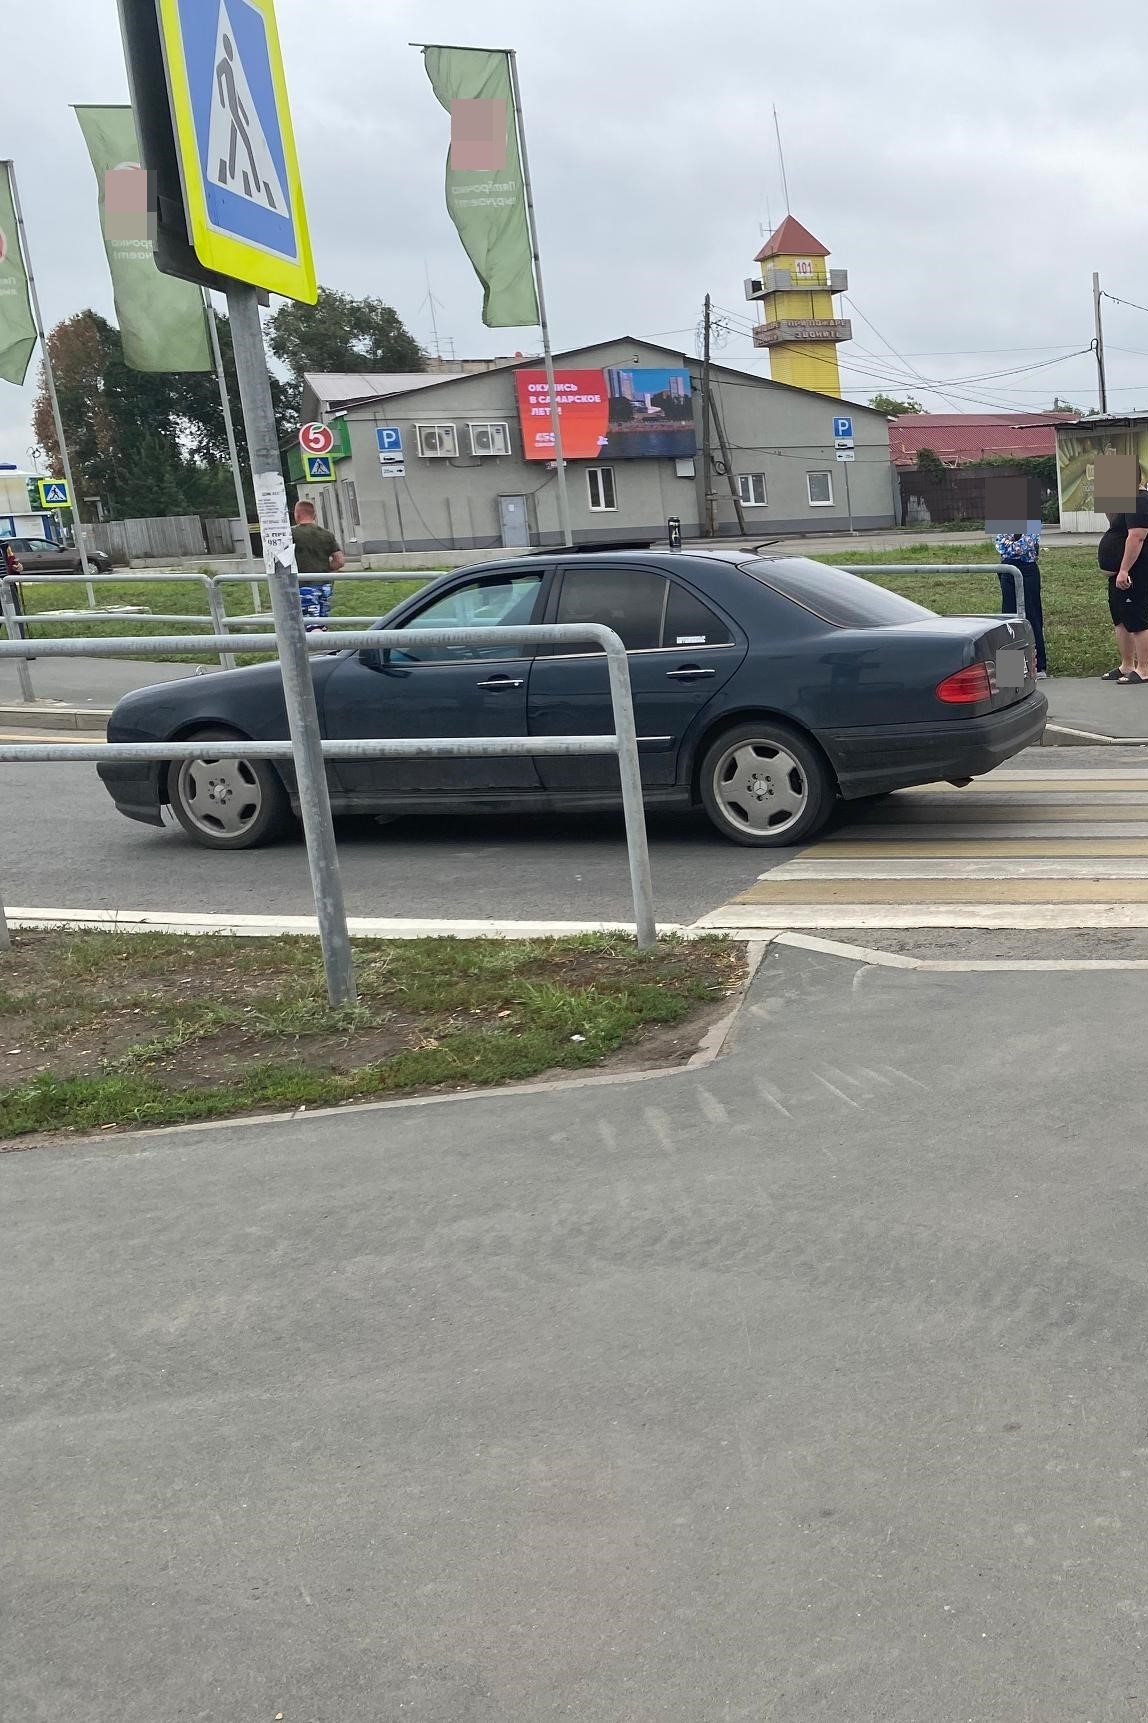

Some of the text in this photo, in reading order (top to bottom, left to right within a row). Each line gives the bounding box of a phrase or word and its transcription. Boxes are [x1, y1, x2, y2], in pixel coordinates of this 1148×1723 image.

[796, 261, 812, 274] 101
[787, 319, 808, 328] ПРИ
[809, 319, 847, 327] ПОЖАРЕ
[795, 329, 841, 339] ЗВОНИТЬ
[529, 395, 537, 404] В
[531, 406, 562, 416] ЛЕТ!
[309, 423, 326, 449] 5
[383, 430, 396, 448] P
